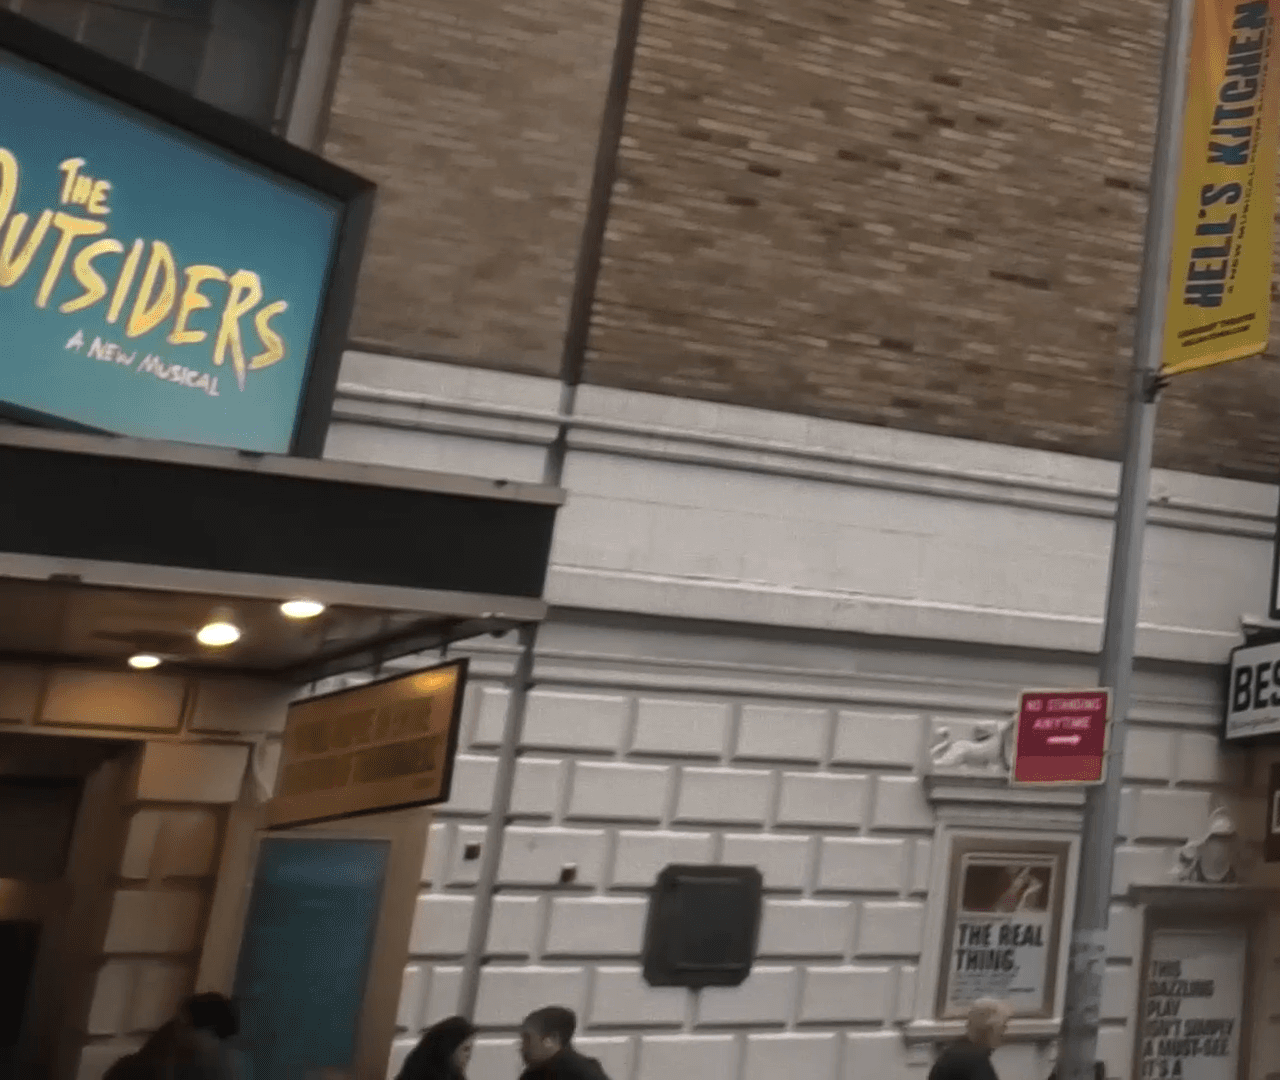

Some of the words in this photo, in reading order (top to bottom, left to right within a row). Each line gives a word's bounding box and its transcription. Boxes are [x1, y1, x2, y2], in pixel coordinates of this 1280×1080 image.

[60, 158, 112, 214] THE
[1182, 182, 1243, 307] HELL'S
[65, 330, 84, 351] A
[87, 336, 137, 366] NEW
[137, 353, 220, 397] MUSICAL
[959, 923, 992, 947] THE
[998, 923, 1043, 947] REAL
[1146, 999, 1181, 1017] PLAY
